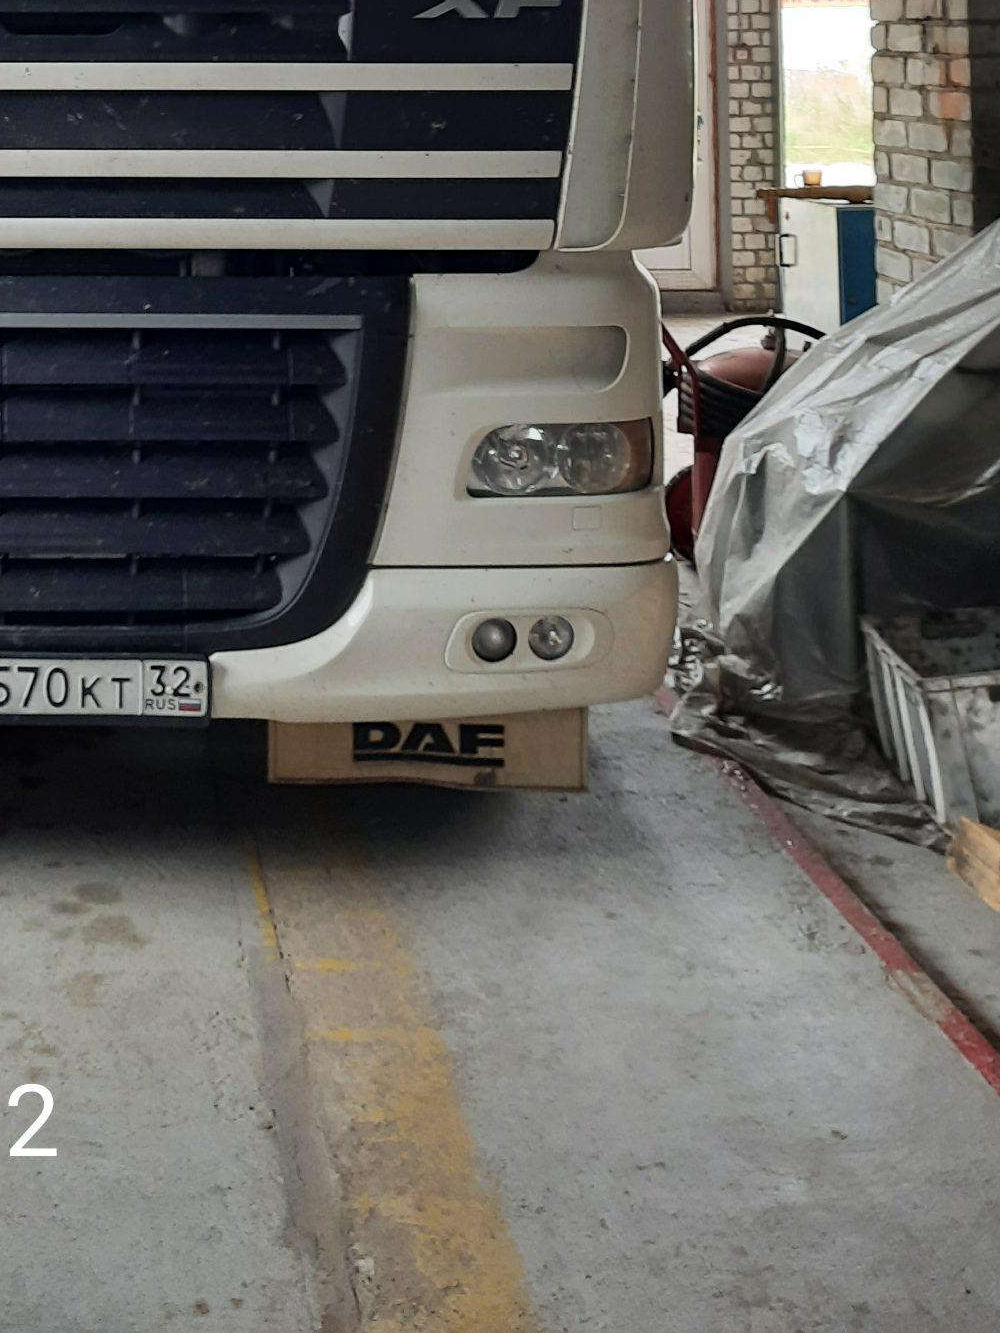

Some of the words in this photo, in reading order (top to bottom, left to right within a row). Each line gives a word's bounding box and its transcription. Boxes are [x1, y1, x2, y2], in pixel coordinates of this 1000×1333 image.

[150, 665, 191, 697] 32
[145, 698, 177, 711] RUS
[352, 721, 506, 757] DAF
